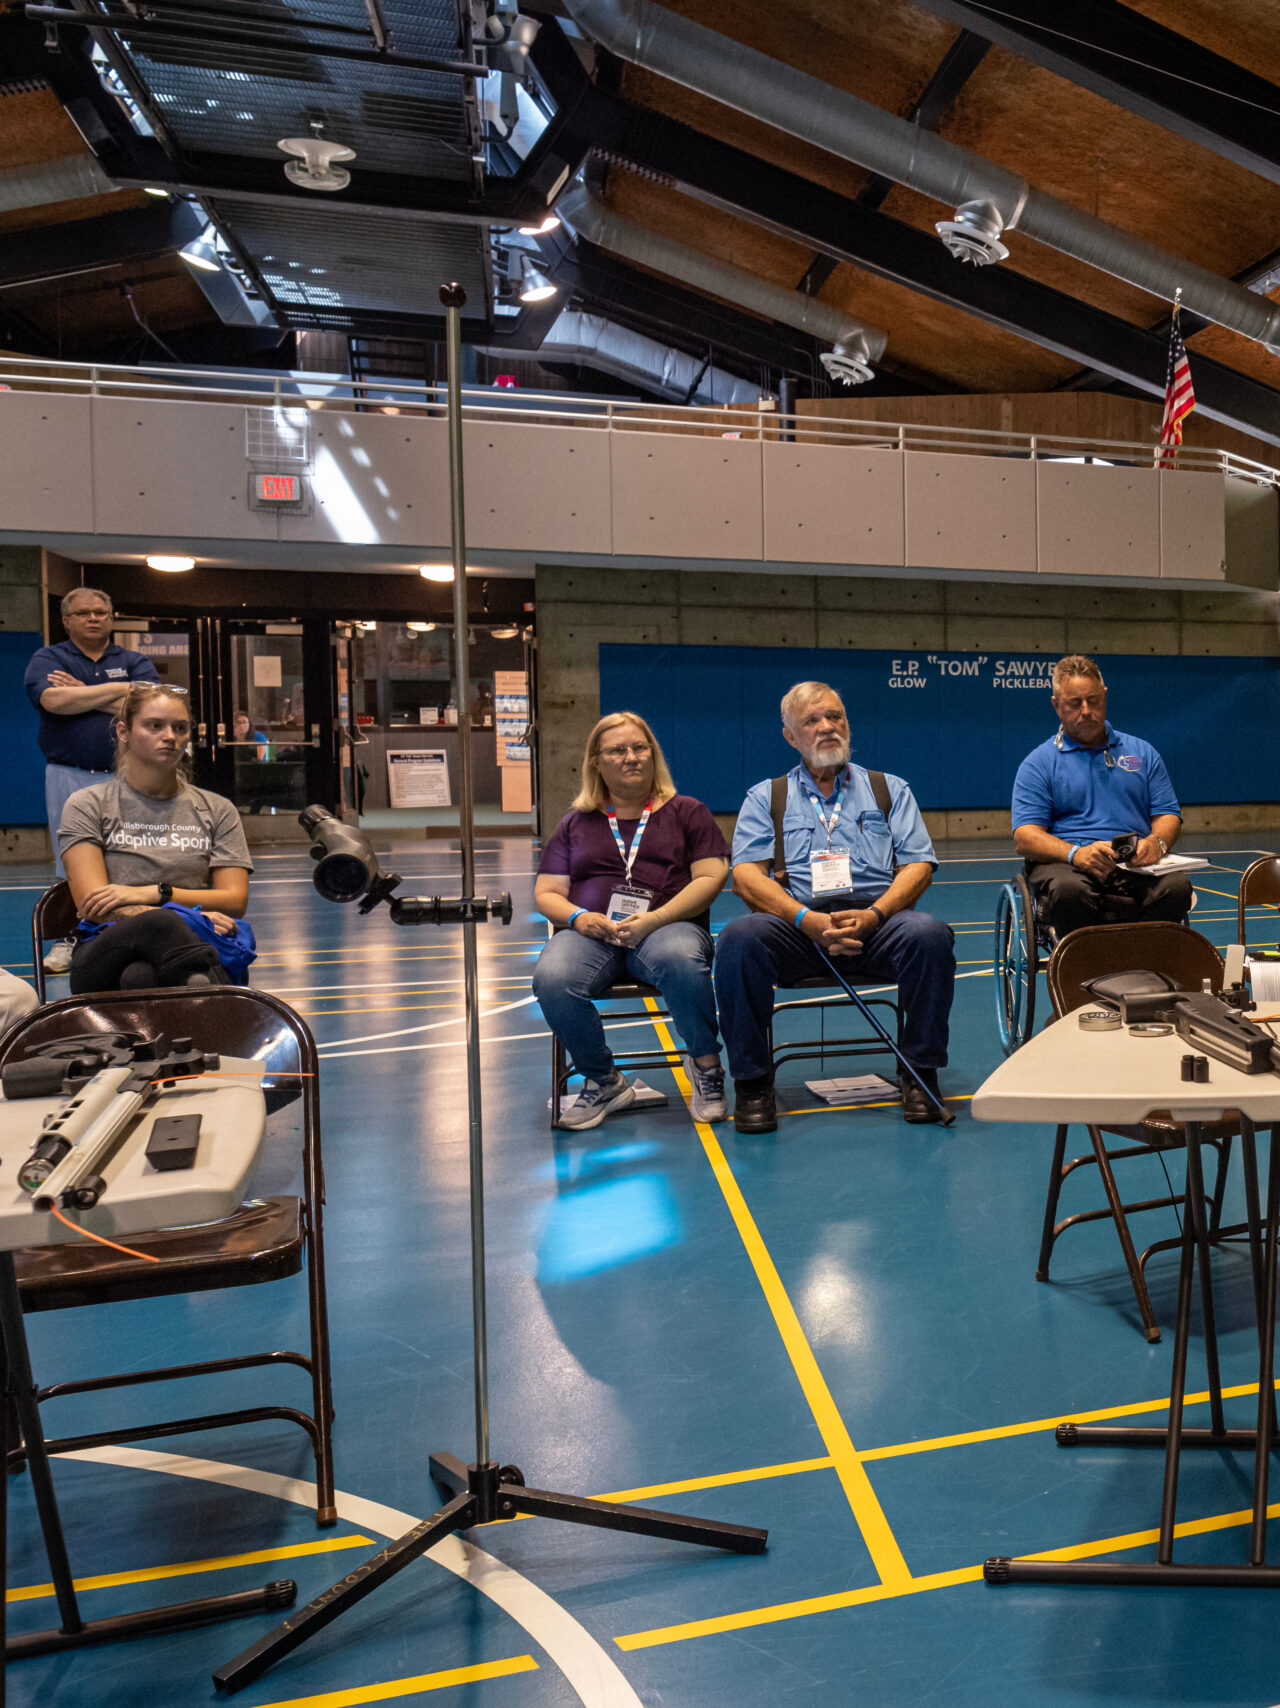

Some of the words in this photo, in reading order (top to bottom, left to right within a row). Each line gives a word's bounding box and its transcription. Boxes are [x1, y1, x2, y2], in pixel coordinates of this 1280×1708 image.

[262, 475, 295, 500] EXIT
[169, 645, 189, 655] ARE
[892, 660, 919, 676] E.P.
[995, 661, 1055, 676] SAWYE
[888, 677, 927, 689] GLOW
[993, 678, 1053, 689] PICKLEBA
[122, 821, 170, 834] illsborough
[171, 823, 202, 834] County
[106, 830, 168, 850] Adaptive
[170, 832, 211, 852] Sport
